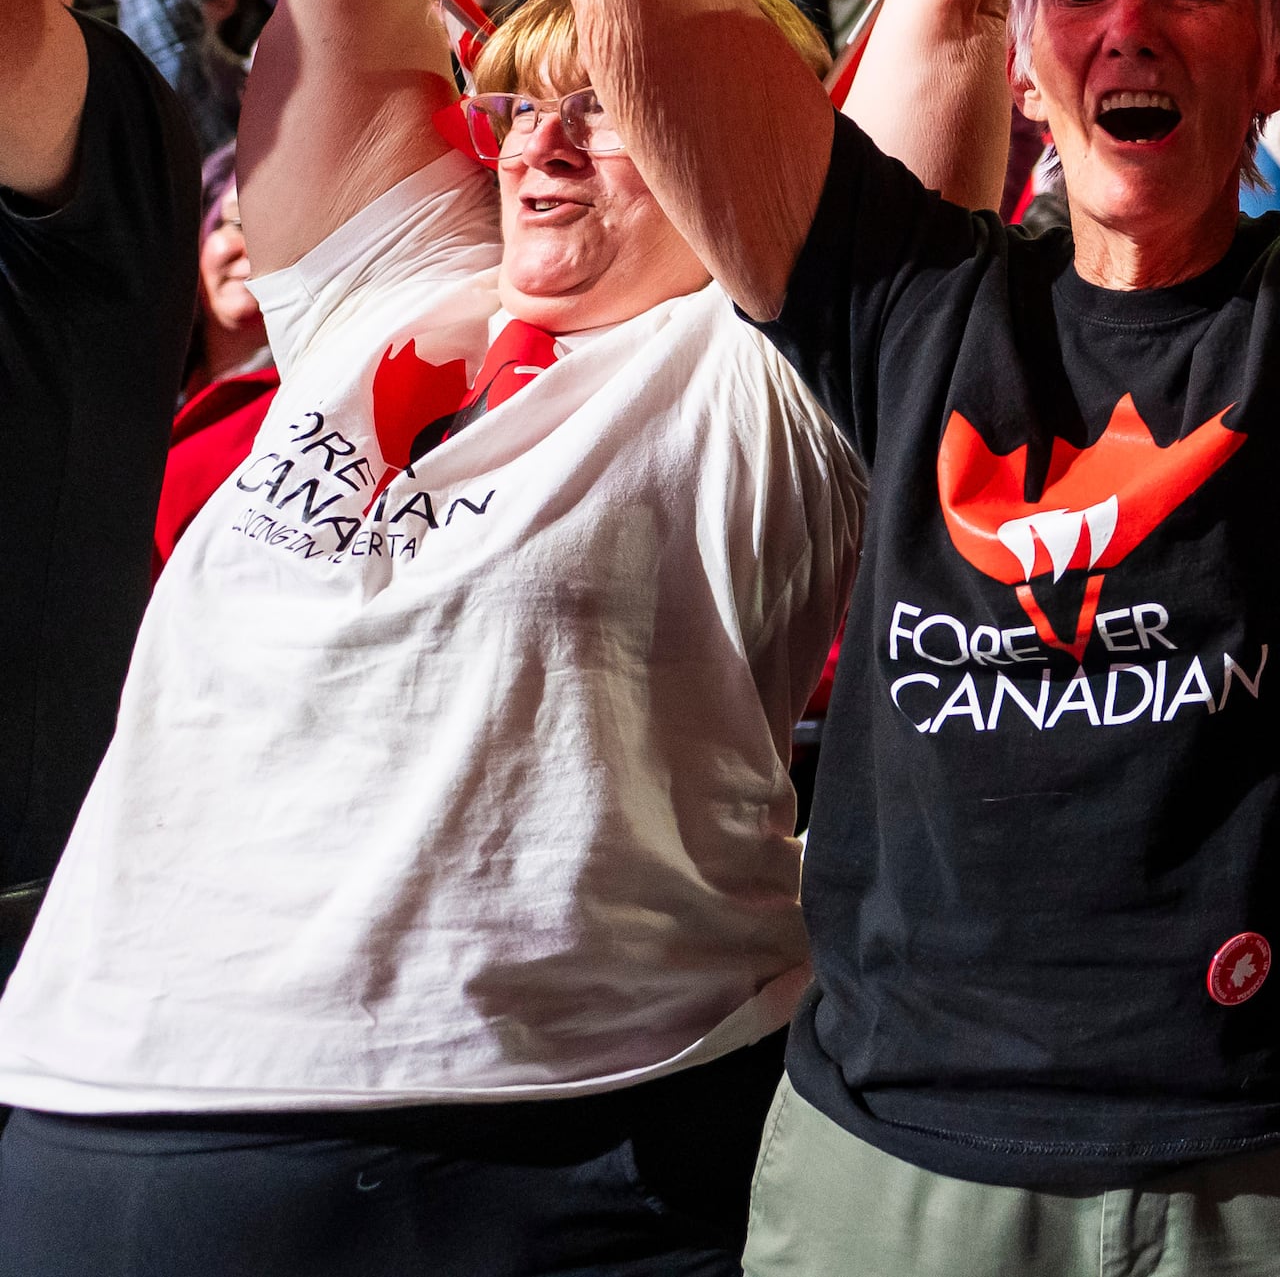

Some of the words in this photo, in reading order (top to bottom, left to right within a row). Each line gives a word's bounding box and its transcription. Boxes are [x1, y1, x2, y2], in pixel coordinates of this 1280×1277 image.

[236, 453, 497, 553] CANAIAN
[889, 573, 1178, 666] FOREVER
[890, 643, 1269, 733] CANADIAN
